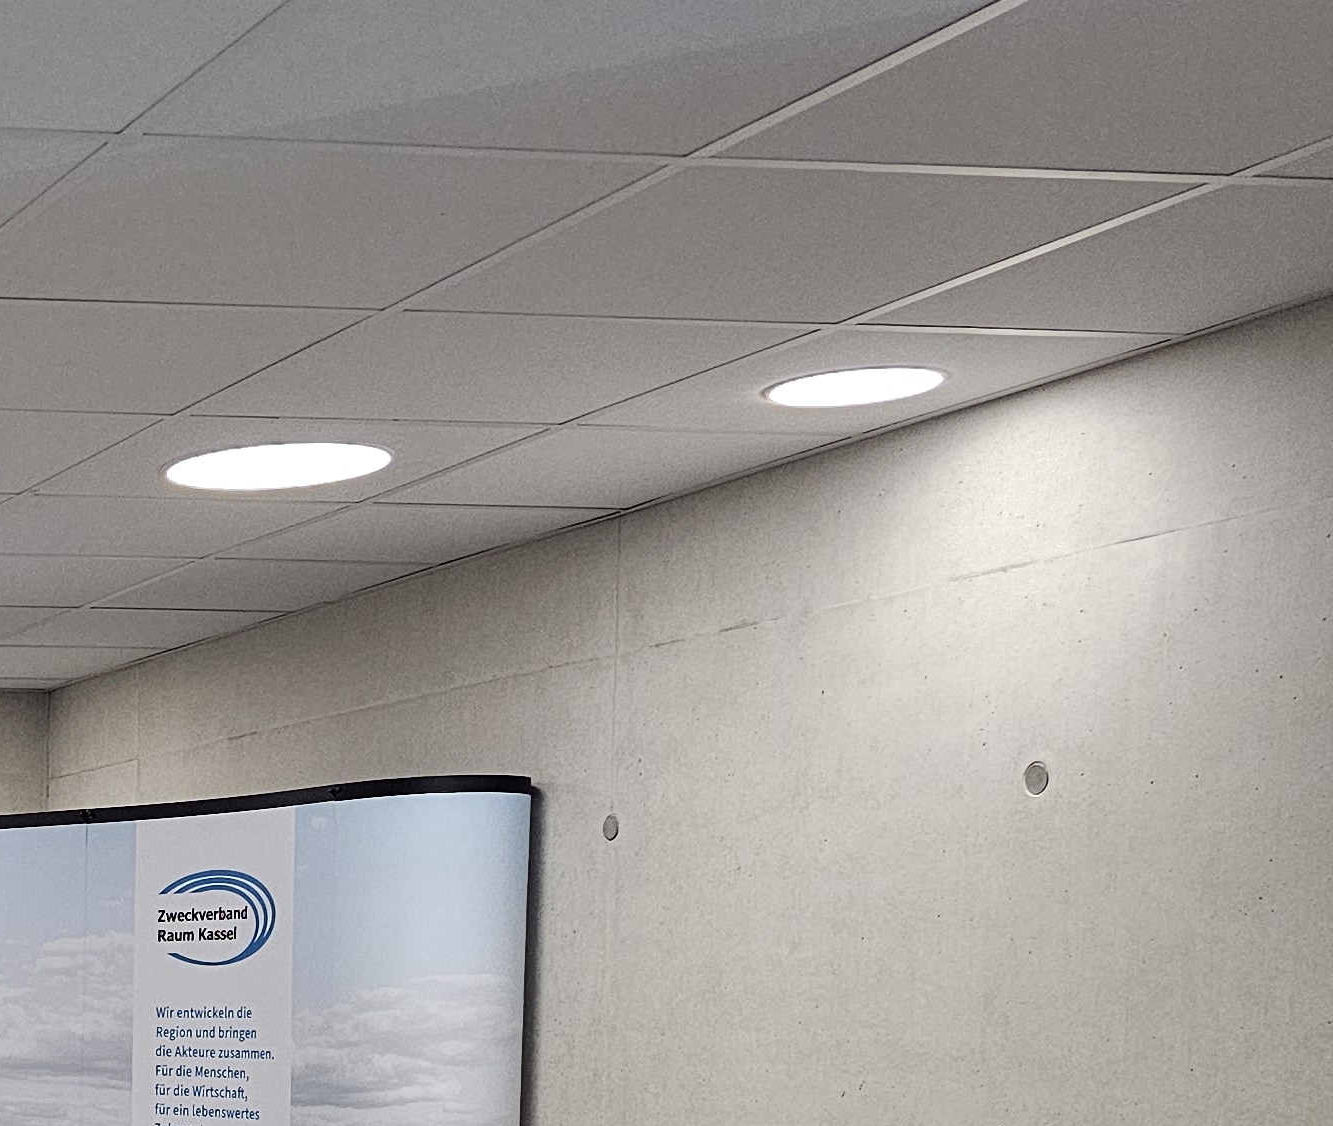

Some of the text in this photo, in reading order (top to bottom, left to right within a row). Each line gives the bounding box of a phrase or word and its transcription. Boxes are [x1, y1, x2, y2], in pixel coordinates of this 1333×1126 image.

[157, 906, 248, 922] Zweckverband
[157, 927, 238, 942] Raum Kassel
[156, 1007, 253, 1019] Wir entwickeln die
[156, 1026, 258, 1042] Region und bringen
[155, 1045, 275, 1060] die Akteure zusammen.
[155, 1064, 250, 1082] Für die Menschen,
[154, 1083, 249, 1101] für die Wirtschaft,
[154, 1103, 261, 1120] für ein lebenswertes
